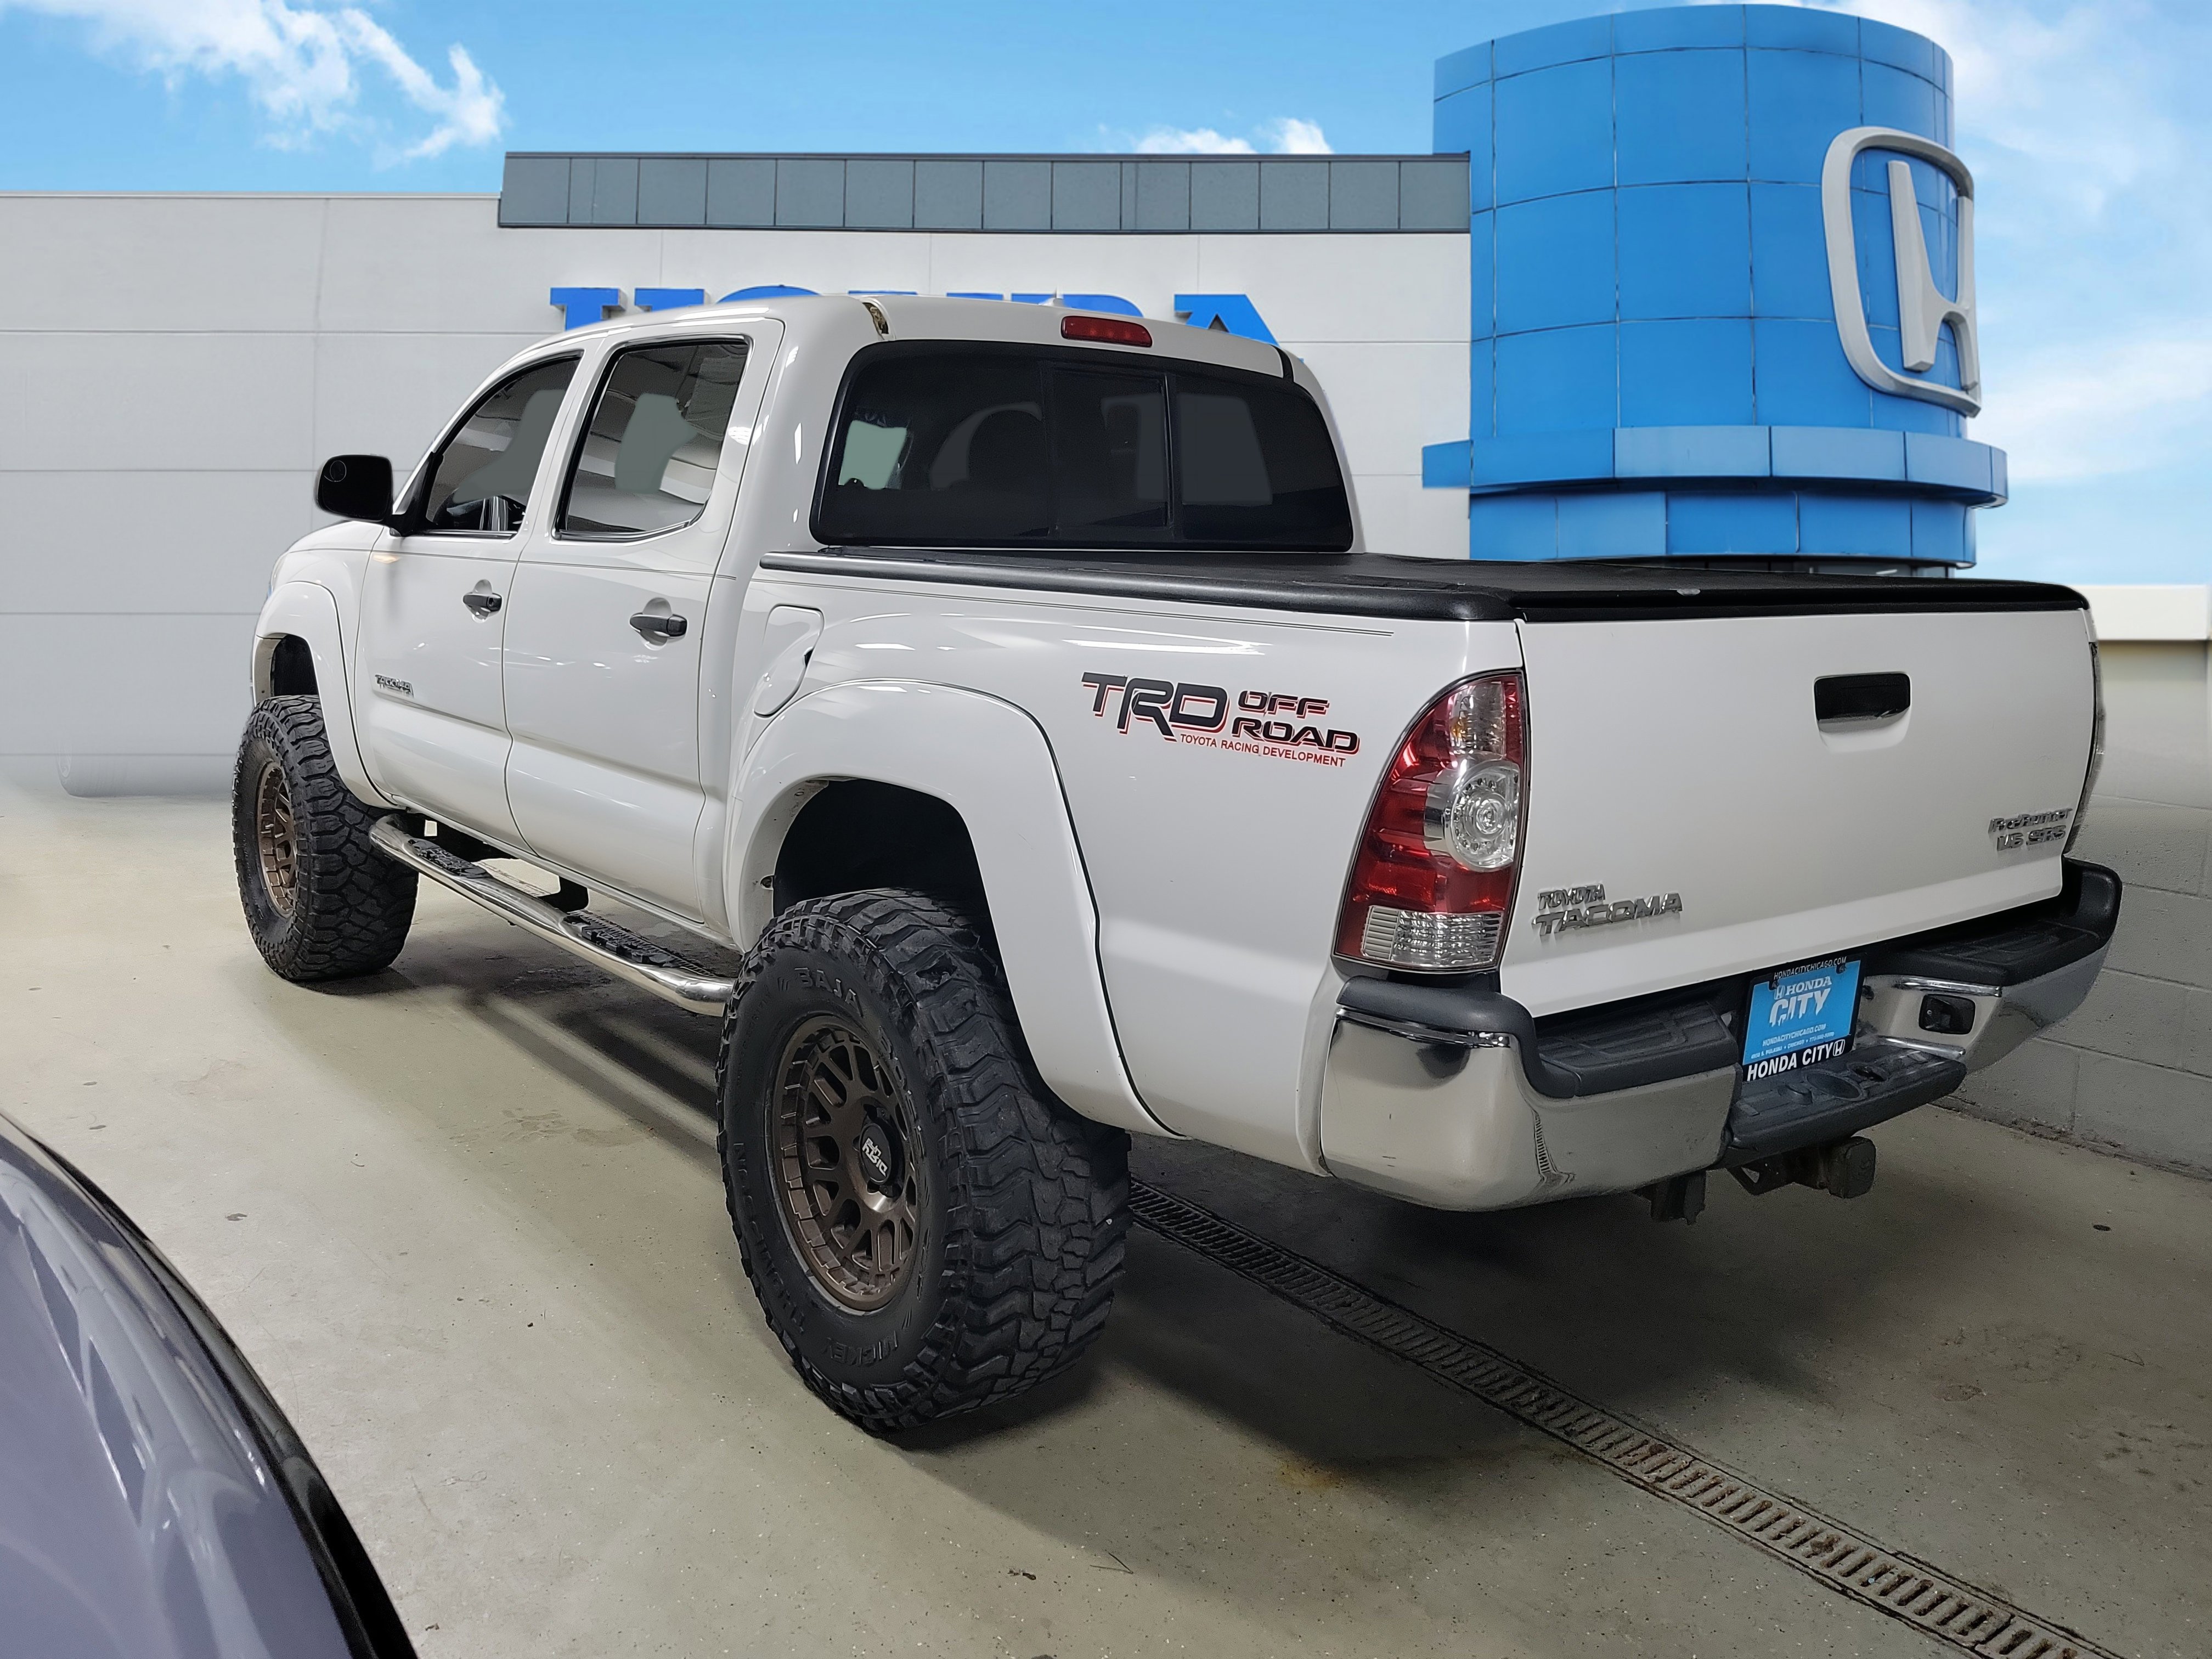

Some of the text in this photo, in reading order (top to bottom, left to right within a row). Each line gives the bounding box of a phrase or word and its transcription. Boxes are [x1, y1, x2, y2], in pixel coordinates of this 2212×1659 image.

[1081, 671, 1230, 743] TRD
[1237, 690, 1330, 719] OFF
[1180, 733, 1346, 768] TOYOTA RACING DEVELOPMENT
[1231, 716, 1361, 755] ROAD
[1532, 893, 1683, 936] TACOMA
[1773, 956, 1847, 980] HONDACITYCHICAGO.COM
[1785, 976, 1832, 996] HONDA
[793, 967, 865, 1019] BAJA
[1769, 988, 1832, 1028] CITY
[1746, 1052, 1798, 1082] HONDA
[1802, 1042, 1835, 1066] CITY
